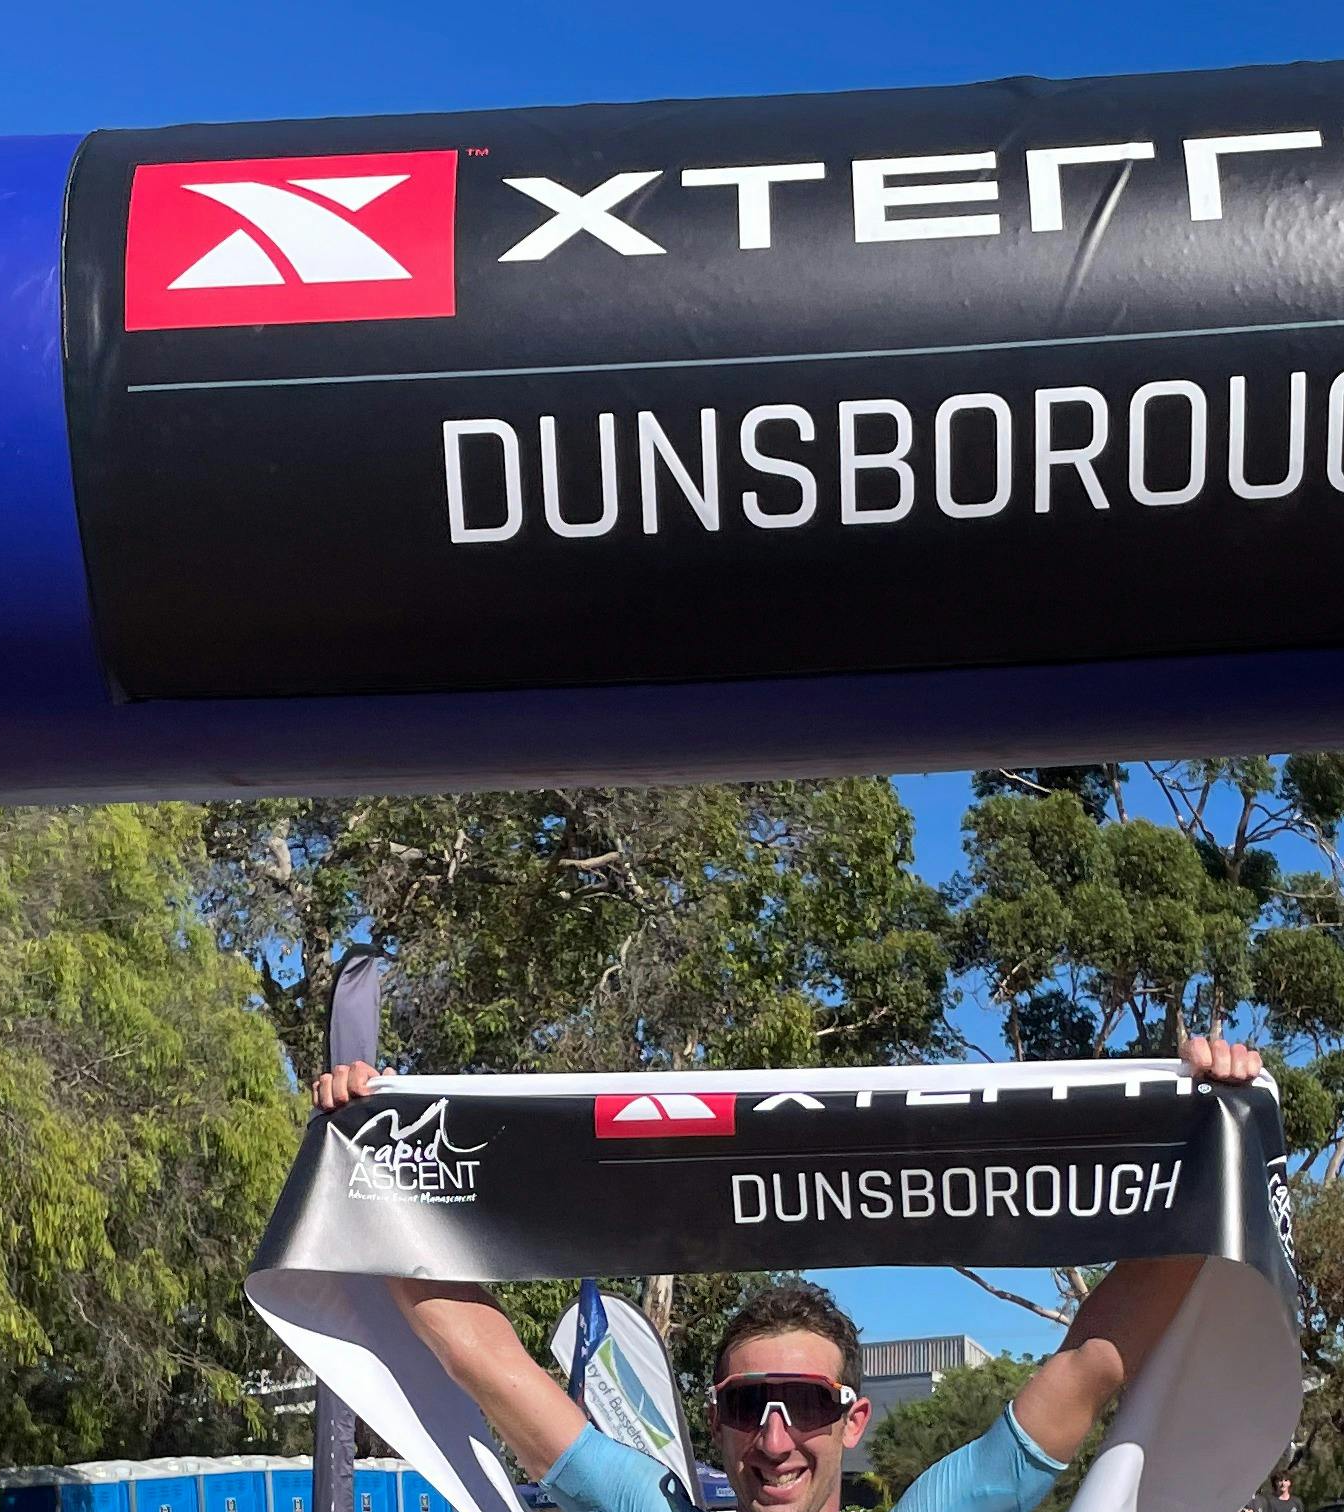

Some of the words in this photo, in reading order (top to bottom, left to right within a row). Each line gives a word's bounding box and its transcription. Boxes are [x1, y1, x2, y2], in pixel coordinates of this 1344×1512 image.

[360, 1129, 442, 1172] rapid
[348, 1160, 481, 1190] ASCENT
[732, 1160, 1182, 1225] DUNSBOROUGH
